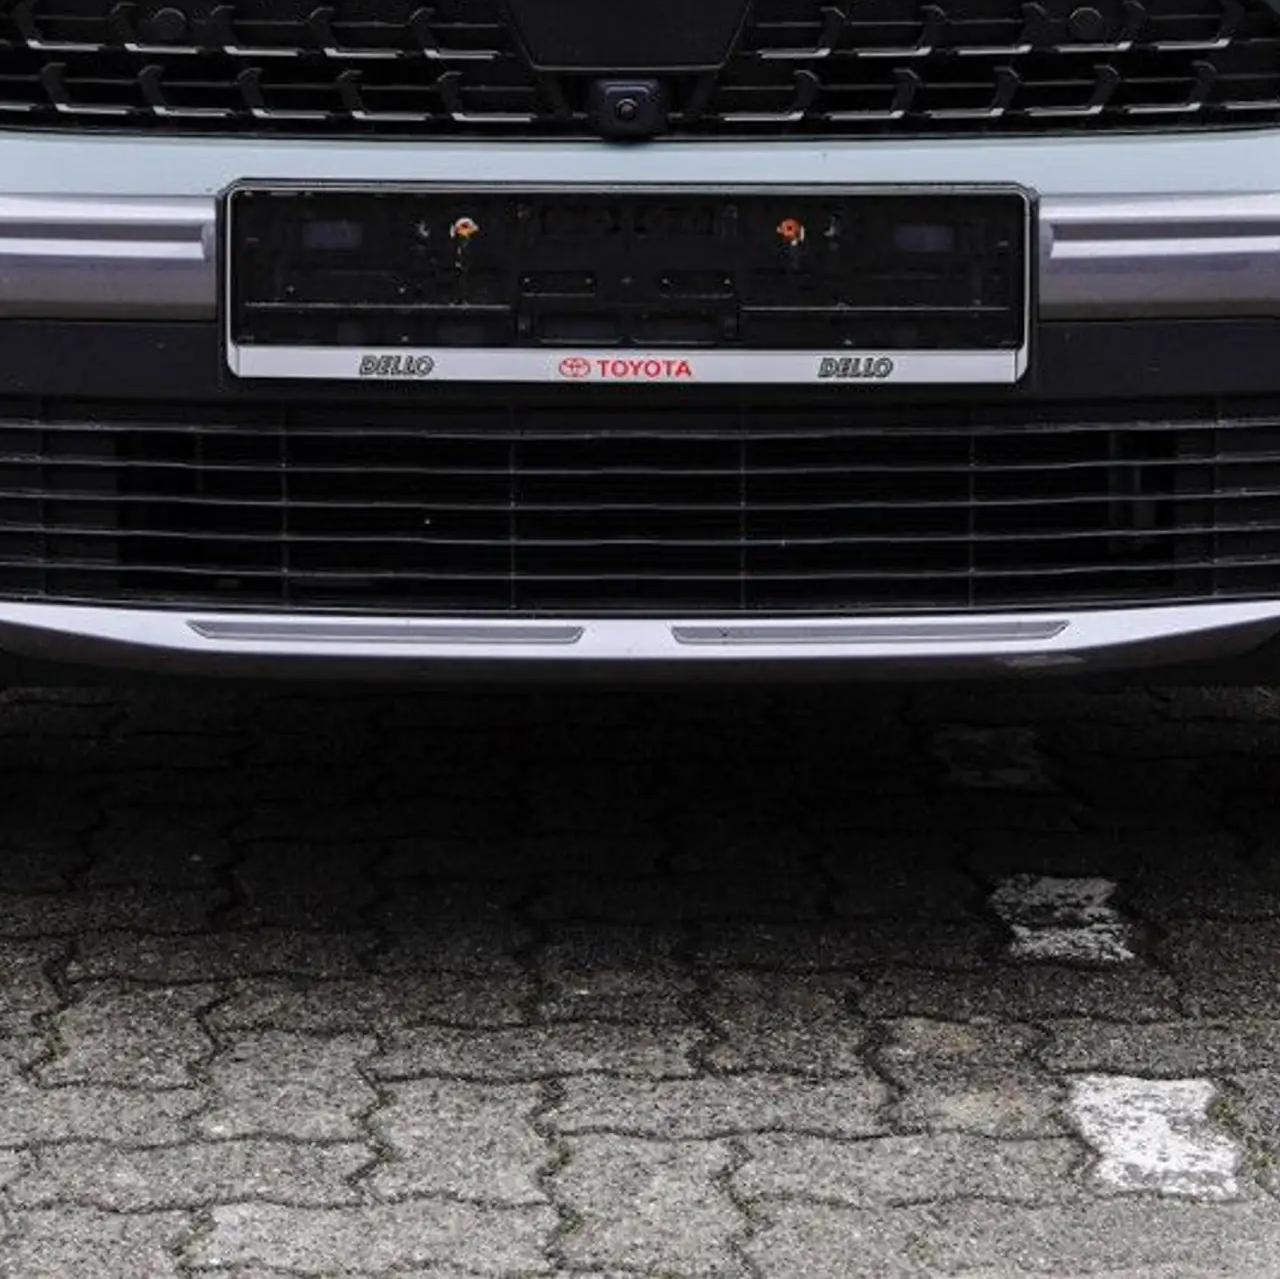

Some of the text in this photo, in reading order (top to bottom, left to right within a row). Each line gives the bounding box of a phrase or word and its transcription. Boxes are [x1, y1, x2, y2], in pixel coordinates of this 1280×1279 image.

[359, 355, 893, 378] DELLO TOYOTA DELLO
